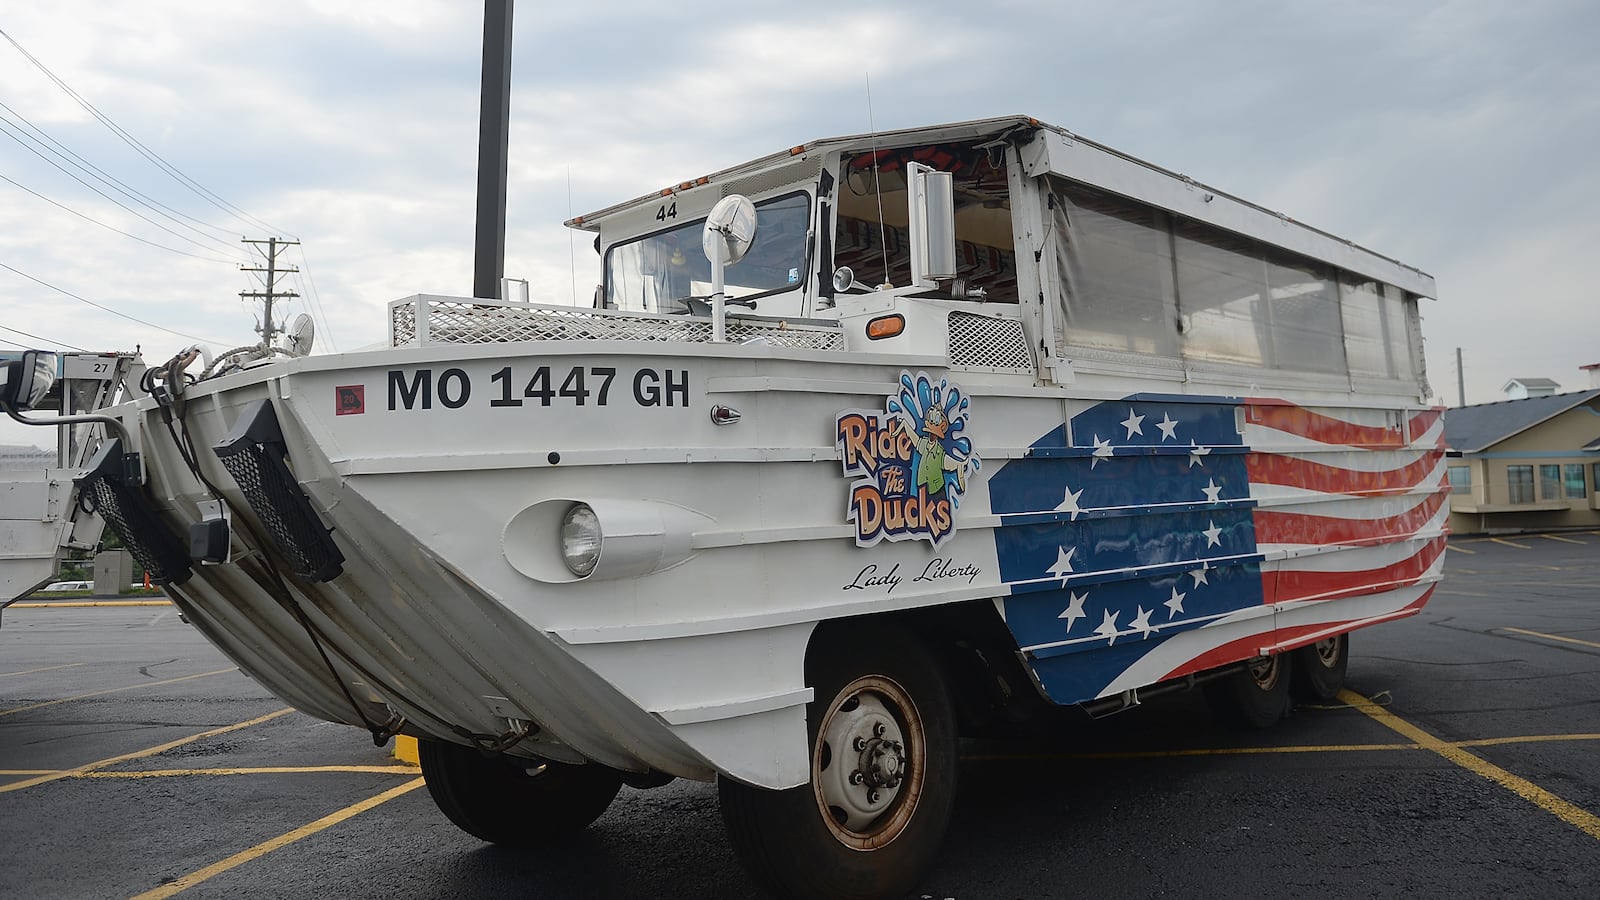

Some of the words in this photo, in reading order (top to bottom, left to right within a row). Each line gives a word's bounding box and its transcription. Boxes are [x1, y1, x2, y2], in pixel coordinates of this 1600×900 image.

[656, 201, 677, 221] 44
[94, 364, 108, 372] 27
[388, 368, 471, 411] MO
[491, 366, 616, 407] 1447
[633, 369, 689, 407] GH
[840, 416, 912, 471] Ride
[855, 486, 951, 538] Ducks
[843, 563, 903, 593] Lady
[912, 558, 981, 583] Liberty
